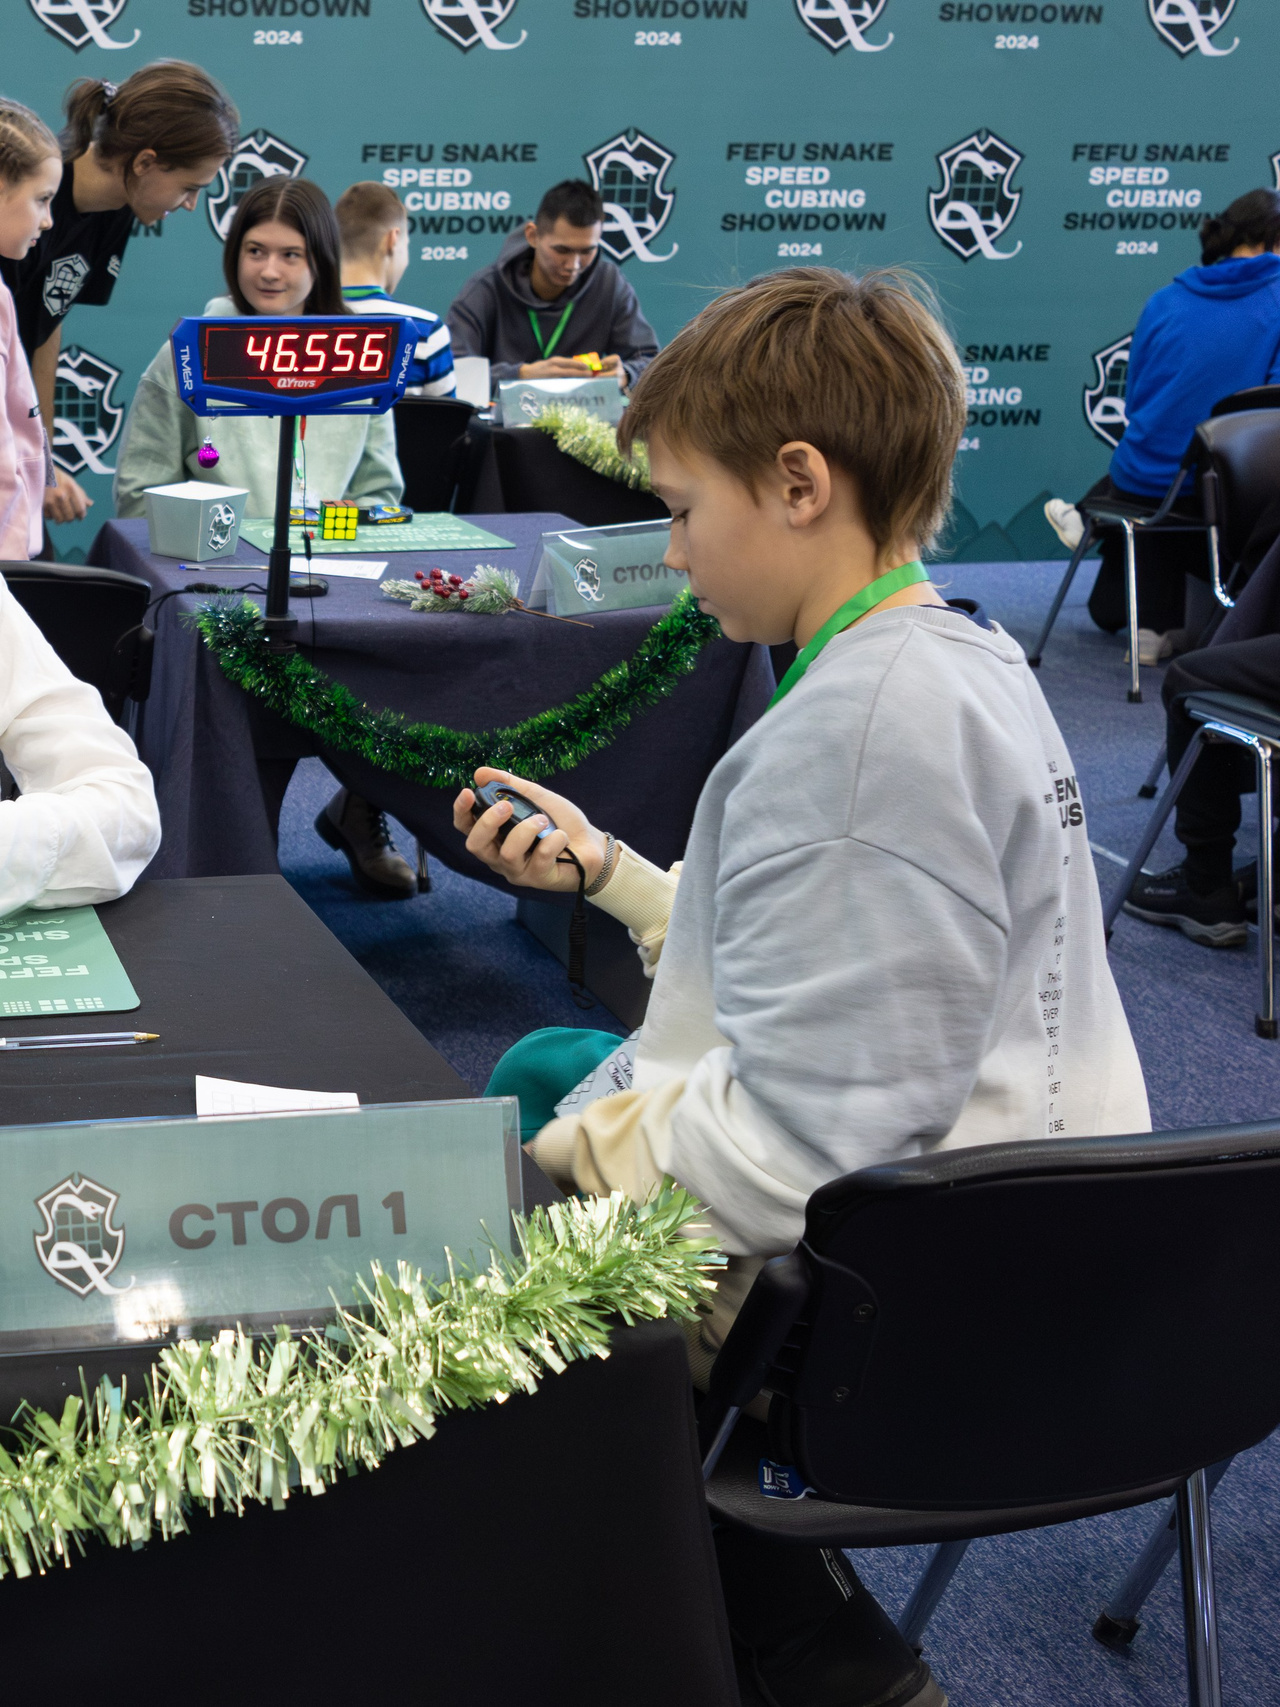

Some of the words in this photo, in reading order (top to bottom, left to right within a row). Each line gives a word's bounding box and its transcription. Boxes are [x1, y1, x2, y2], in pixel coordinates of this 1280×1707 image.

[189, 0, 370, 17] SHOWDOWN
[573, 0, 747, 19] SHOWDOWN
[938, 2, 1103, 24] SHOWDOWN
[253, 30, 303, 46] 2024
[634, 31, 682, 46] 2024
[994, 34, 1039, 49] 2024
[361, 144, 435, 163] FEFU
[441, 143, 538, 163] SNAKE
[726, 143, 796, 162] FEFU
[803, 142, 894, 162] SNAKE
[1072, 144, 1138, 162] FEFU
[1144, 143, 1231, 163] SNAKE
[382, 168, 473, 187] SPEED
[745, 166, 830, 186] SPEED
[1088, 166, 1169, 186] SPEED
[404, 191, 511, 211] CUBING
[765, 189, 866, 208] CUBING
[1106, 188, 1202, 208] CUBING
[720, 212, 887, 232] SHOWDOWN
[421, 246, 468, 260] 2024
[777, 243, 822, 257] 2024
[1116, 241, 1158, 255] 2024
[246, 333, 388, 373] 46.556
[964, 343, 1051, 362] SNAKE
[179, 345, 194, 391] TIMER
[396, 343, 412, 387] TIMER
[965, 387, 1023, 405] BING
[613, 564, 669, 584] СТОЛ
[168, 1193, 362, 1251] СТОЛ
[380, 1191, 408, 1235] 1
